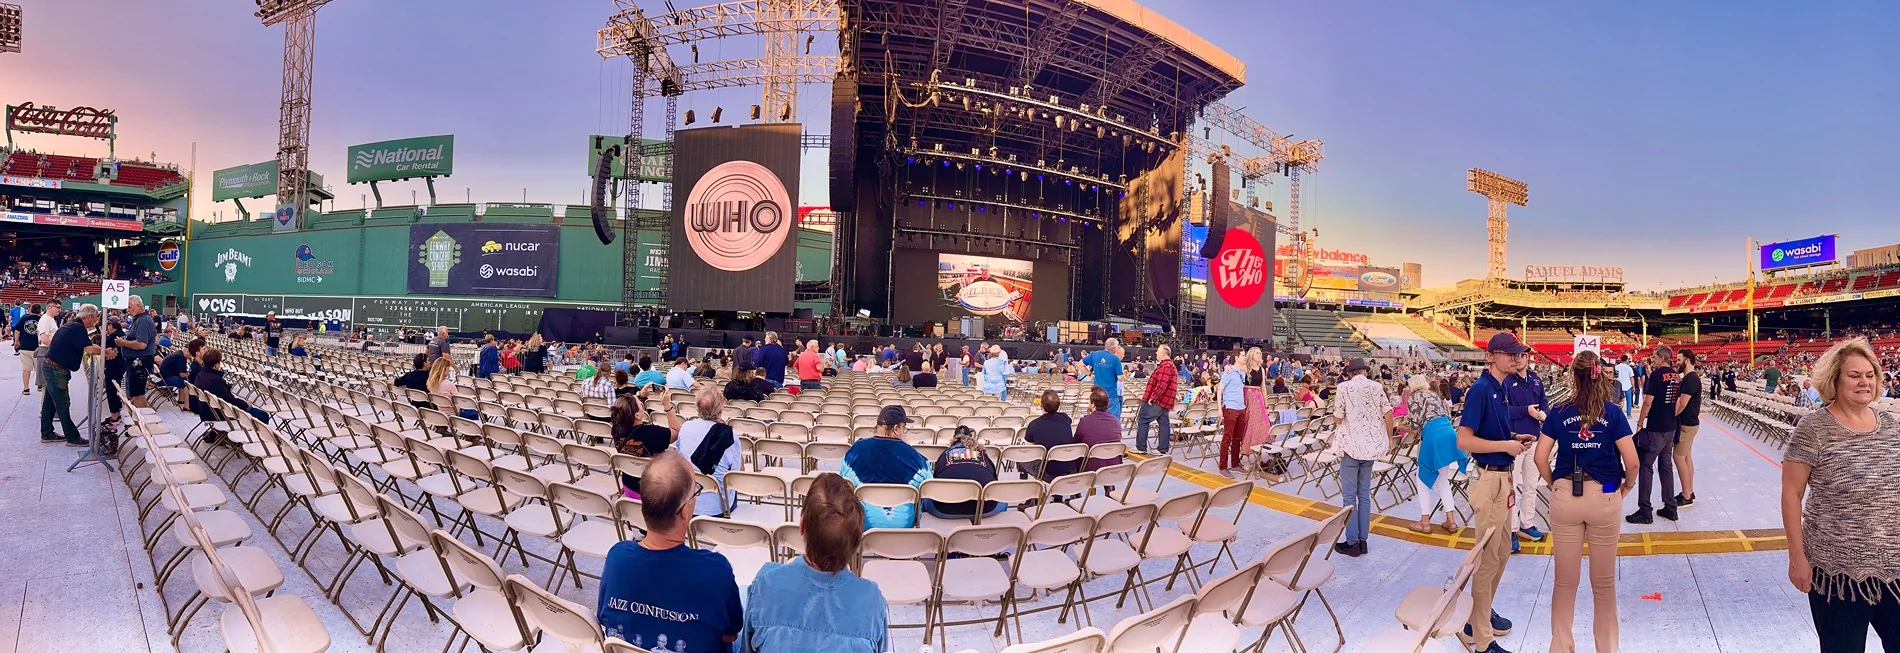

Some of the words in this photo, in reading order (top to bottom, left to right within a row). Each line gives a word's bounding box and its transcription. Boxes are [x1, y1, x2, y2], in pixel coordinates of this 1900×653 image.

[374, 144, 443, 165] National
[412, 162, 439, 170] Rental
[219, 173, 248, 187] Plymouth
[252, 171, 270, 182] Rock
[691, 200, 782, 234] WHO
[506, 242, 540, 251] nucar
[1785, 242, 1822, 256] wasabi
[159, 250, 178, 260] Gulf
[215, 251, 229, 268] JIM
[1321, 248, 1368, 263] balance
[496, 266, 537, 277] wasabi
[1526, 265, 1577, 279] SAMUEL
[1579, 265, 1623, 279] ADAMS
[1368, 275, 1389, 285] Ford
[106, 283, 125, 292] A5
[210, 298, 236, 313] CVS
[1578, 338, 1597, 347] A4
[608, 597, 628, 611] JAZZ
[630, 602, 699, 622] CONFUSION
